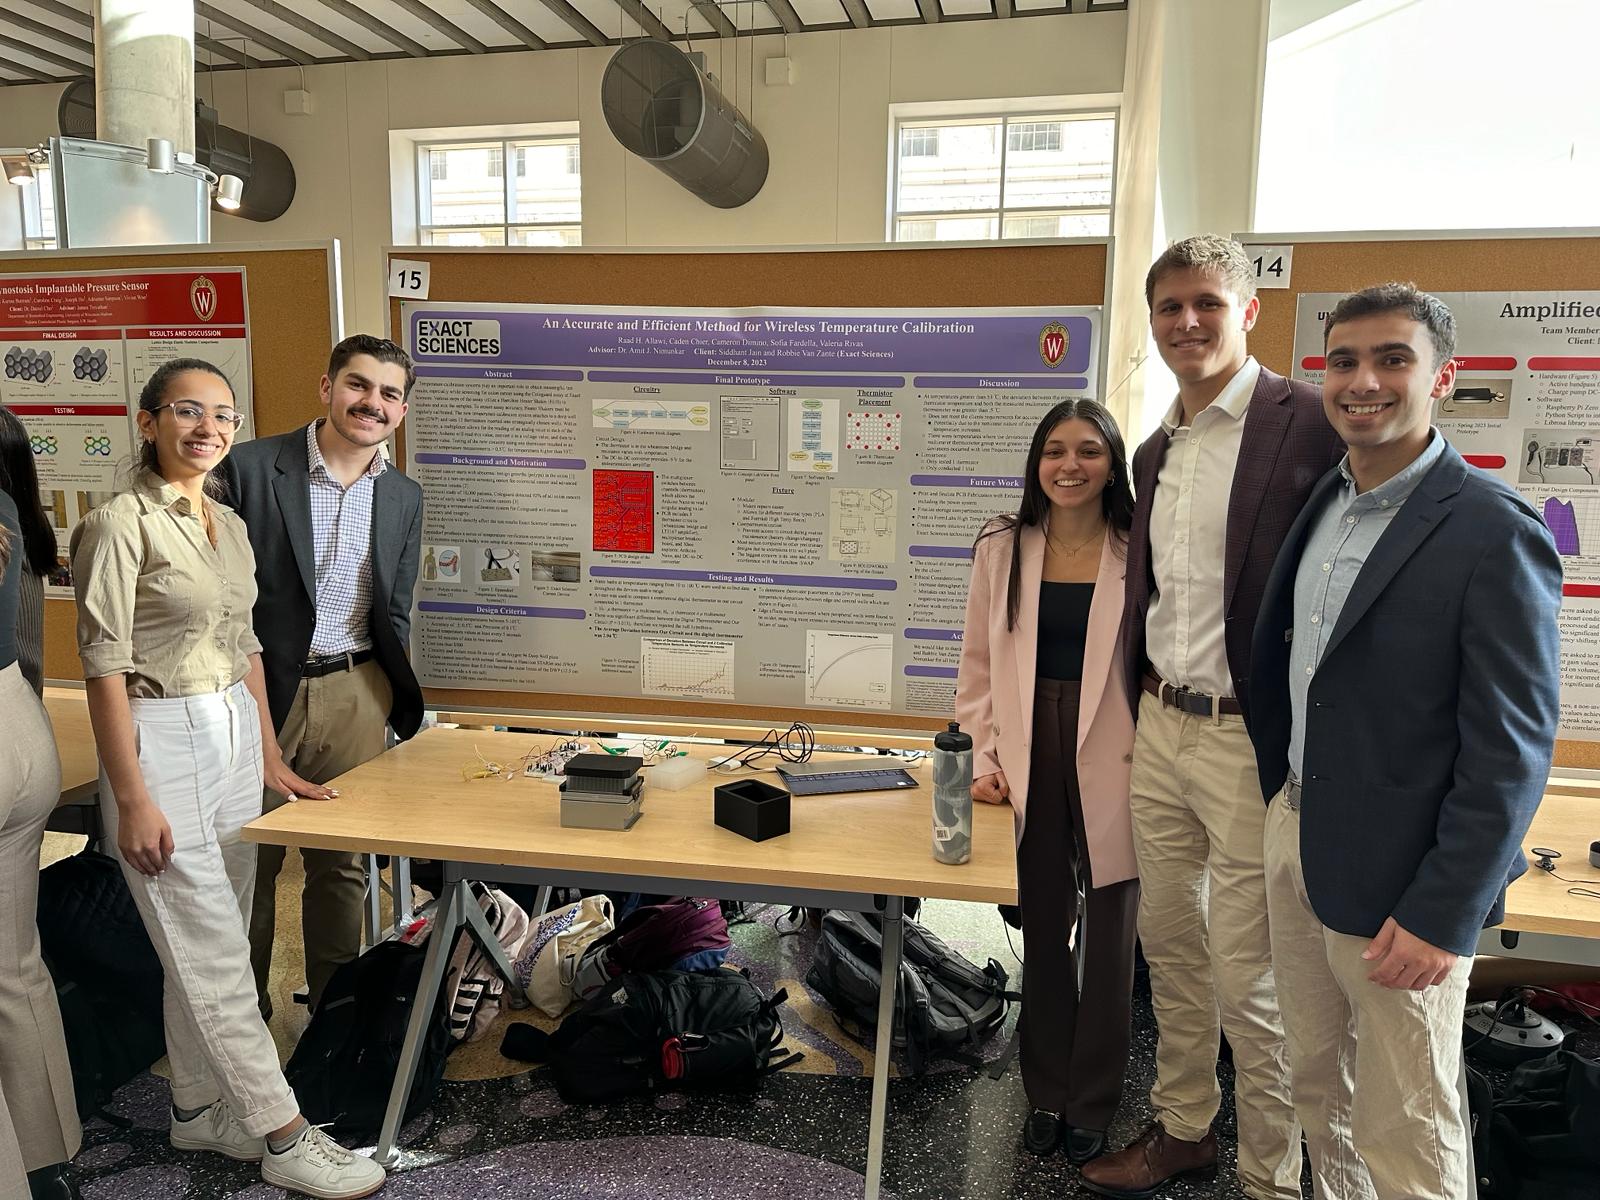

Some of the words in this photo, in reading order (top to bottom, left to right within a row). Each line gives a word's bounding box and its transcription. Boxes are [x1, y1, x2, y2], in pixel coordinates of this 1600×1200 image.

[1253, 256, 1283, 277] 14
[398, 270, 422, 290] 15
[36, 283, 84, 295] Implantable
[87, 282, 119, 292] Pressure
[122, 281, 149, 291] Sensor
[419, 321, 472, 337] EXACT
[543, 318, 559, 329] An
[562, 319, 614, 330] Accurate
[617, 320, 638, 330] and
[642, 320, 691, 331] Efficient
[695, 321, 740, 332] Method
[744, 321, 761, 332] for
[765, 321, 815, 333] Wireless
[819, 322, 899, 335] Temperature
[902, 322, 975, 334] Calibration
[418, 338, 500, 355] SCIENCES
[770, 339, 788, 347] Sofia
[789, 340, 818, 348] Fardella,
[777, 349, 800, 357] Robbie
[837, 350, 859, 358] (Exact
[743, 359, 750, 367] 8,
[751, 359, 767, 367] 2023
[715, 376, 733, 384] Final
[735, 377, 770, 385] Prototype
[452, 457, 494, 466] Background
[510, 459, 547, 467] Motivation
[970, 478, 996, 486] Future
[998, 479, 1019, 487] Work
[708, 573, 733, 582] Testing
[476, 606, 498, 615] Design
[500, 607, 527, 616] Criteria
